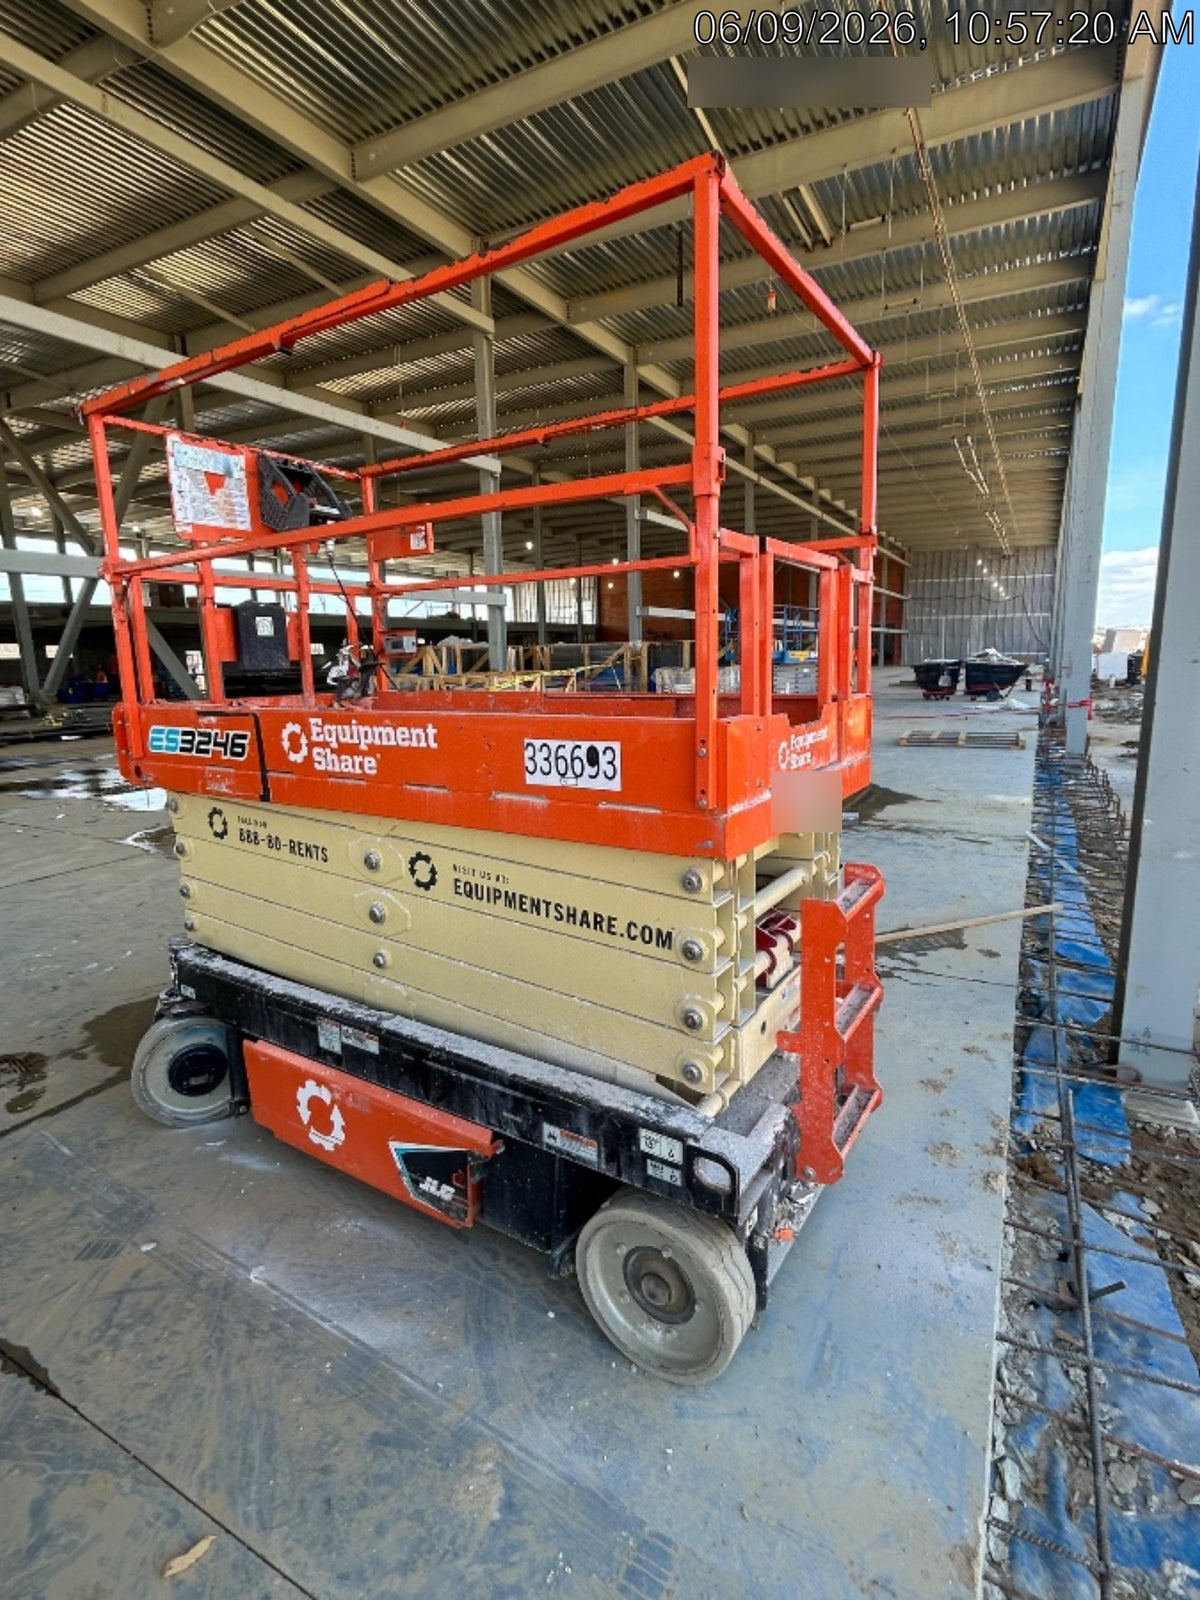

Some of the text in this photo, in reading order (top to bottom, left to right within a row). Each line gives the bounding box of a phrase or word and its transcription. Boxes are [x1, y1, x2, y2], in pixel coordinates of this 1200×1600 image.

[149, 726, 250, 760] ES3246
[309, 717, 438, 750] Equipment
[312, 746, 378, 775] Share
[525, 742, 616, 781] 336693
[454, 878, 673, 950] EQUIPMENTSHARE.COM
